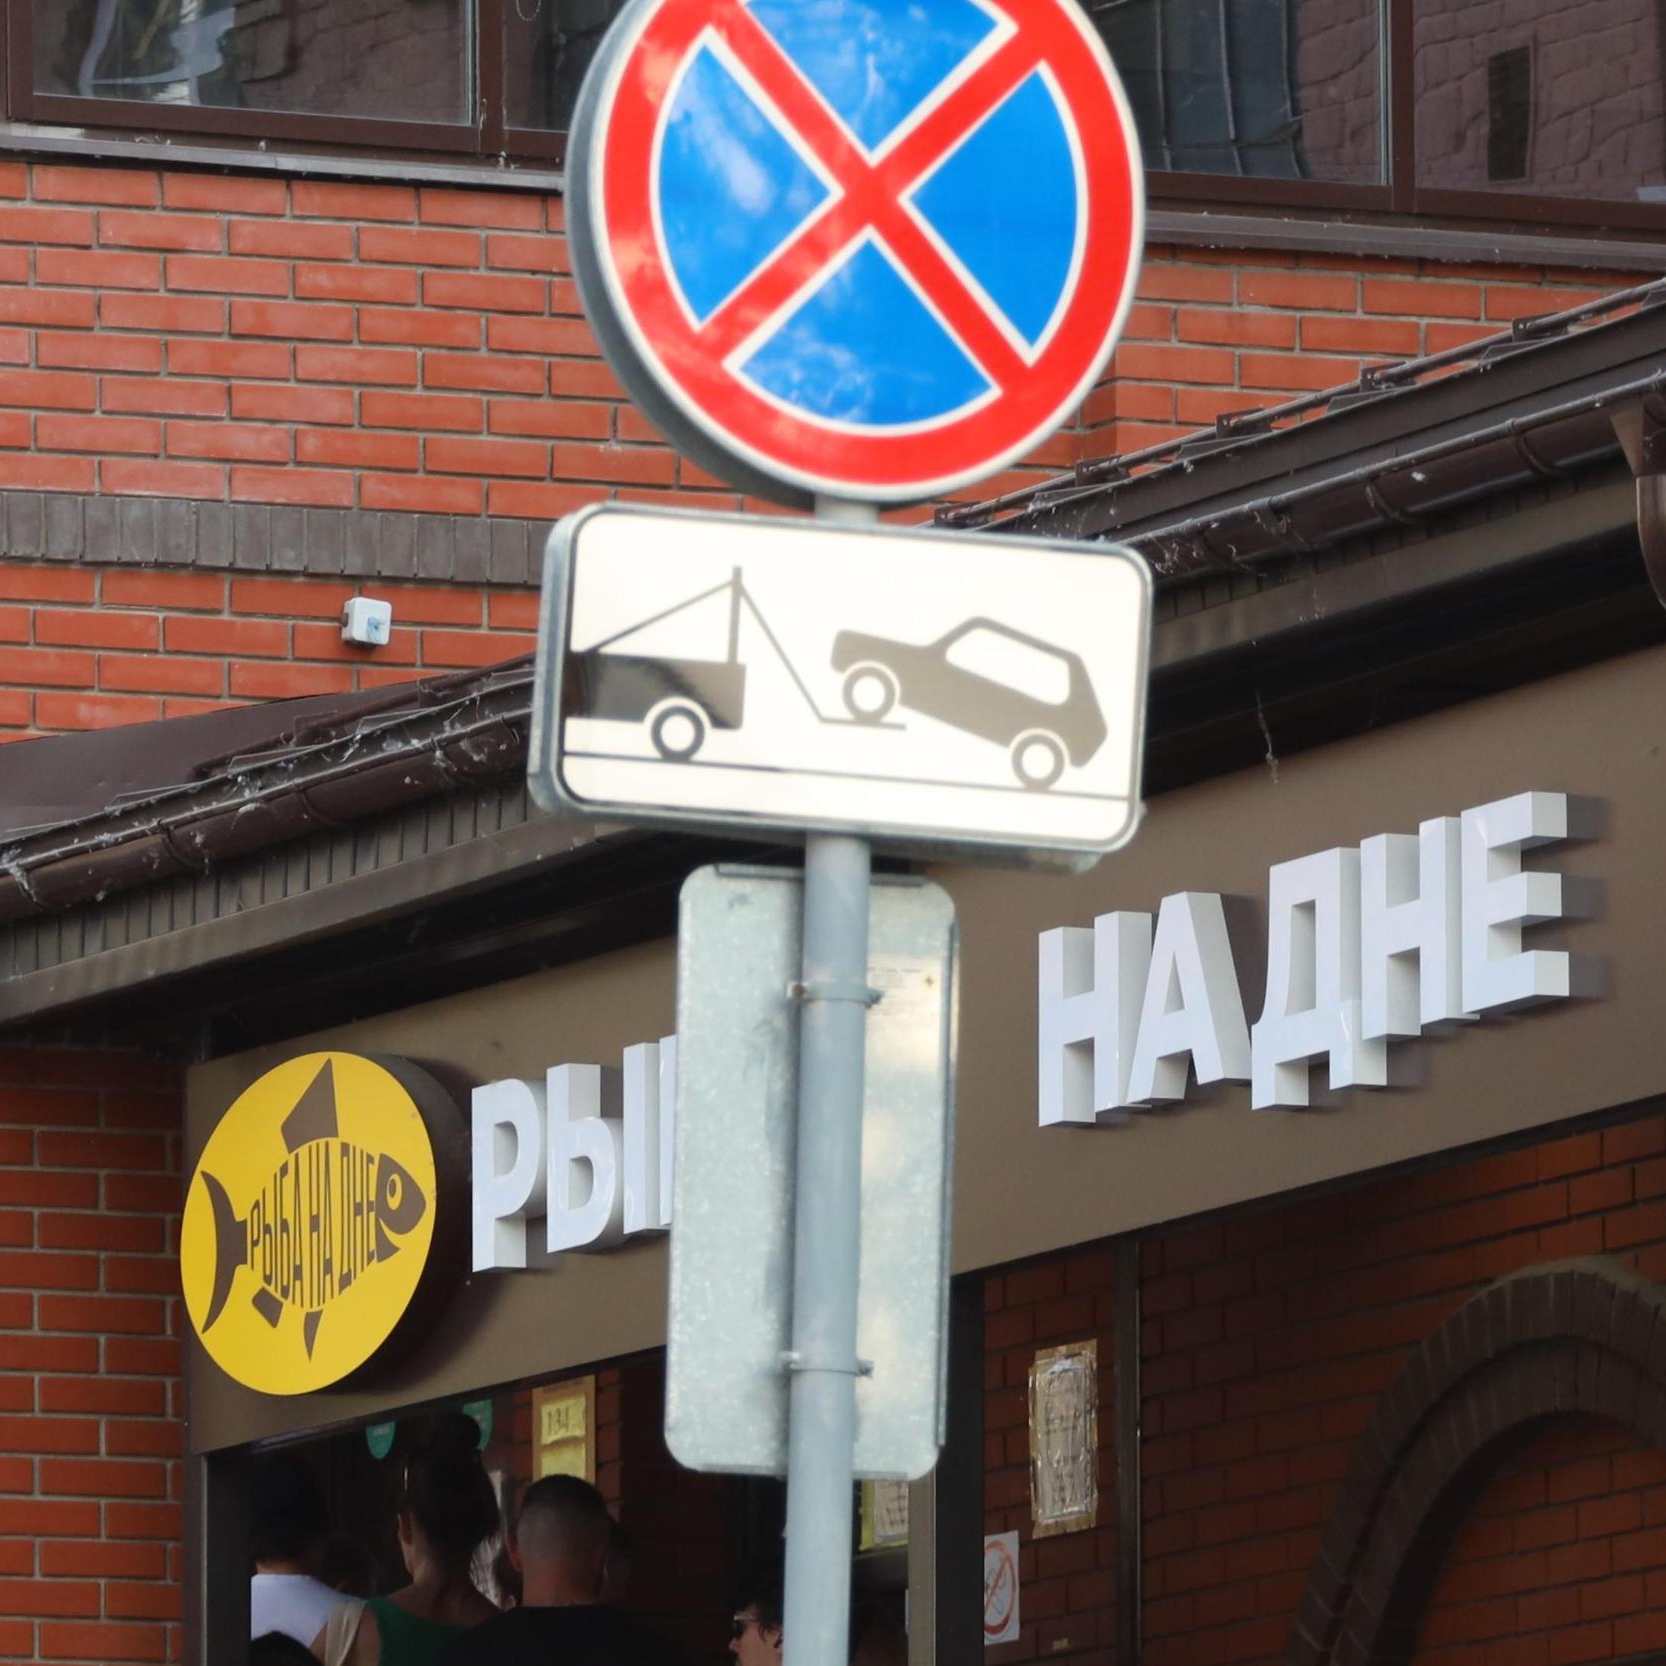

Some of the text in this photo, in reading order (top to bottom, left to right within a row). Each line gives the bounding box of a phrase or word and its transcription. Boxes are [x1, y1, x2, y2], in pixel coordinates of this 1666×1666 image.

[471, 791, 1570, 1273] РЫ НА ДНЕ
[249, 1141, 377, 1309] РЫБА НА ДНЕ
